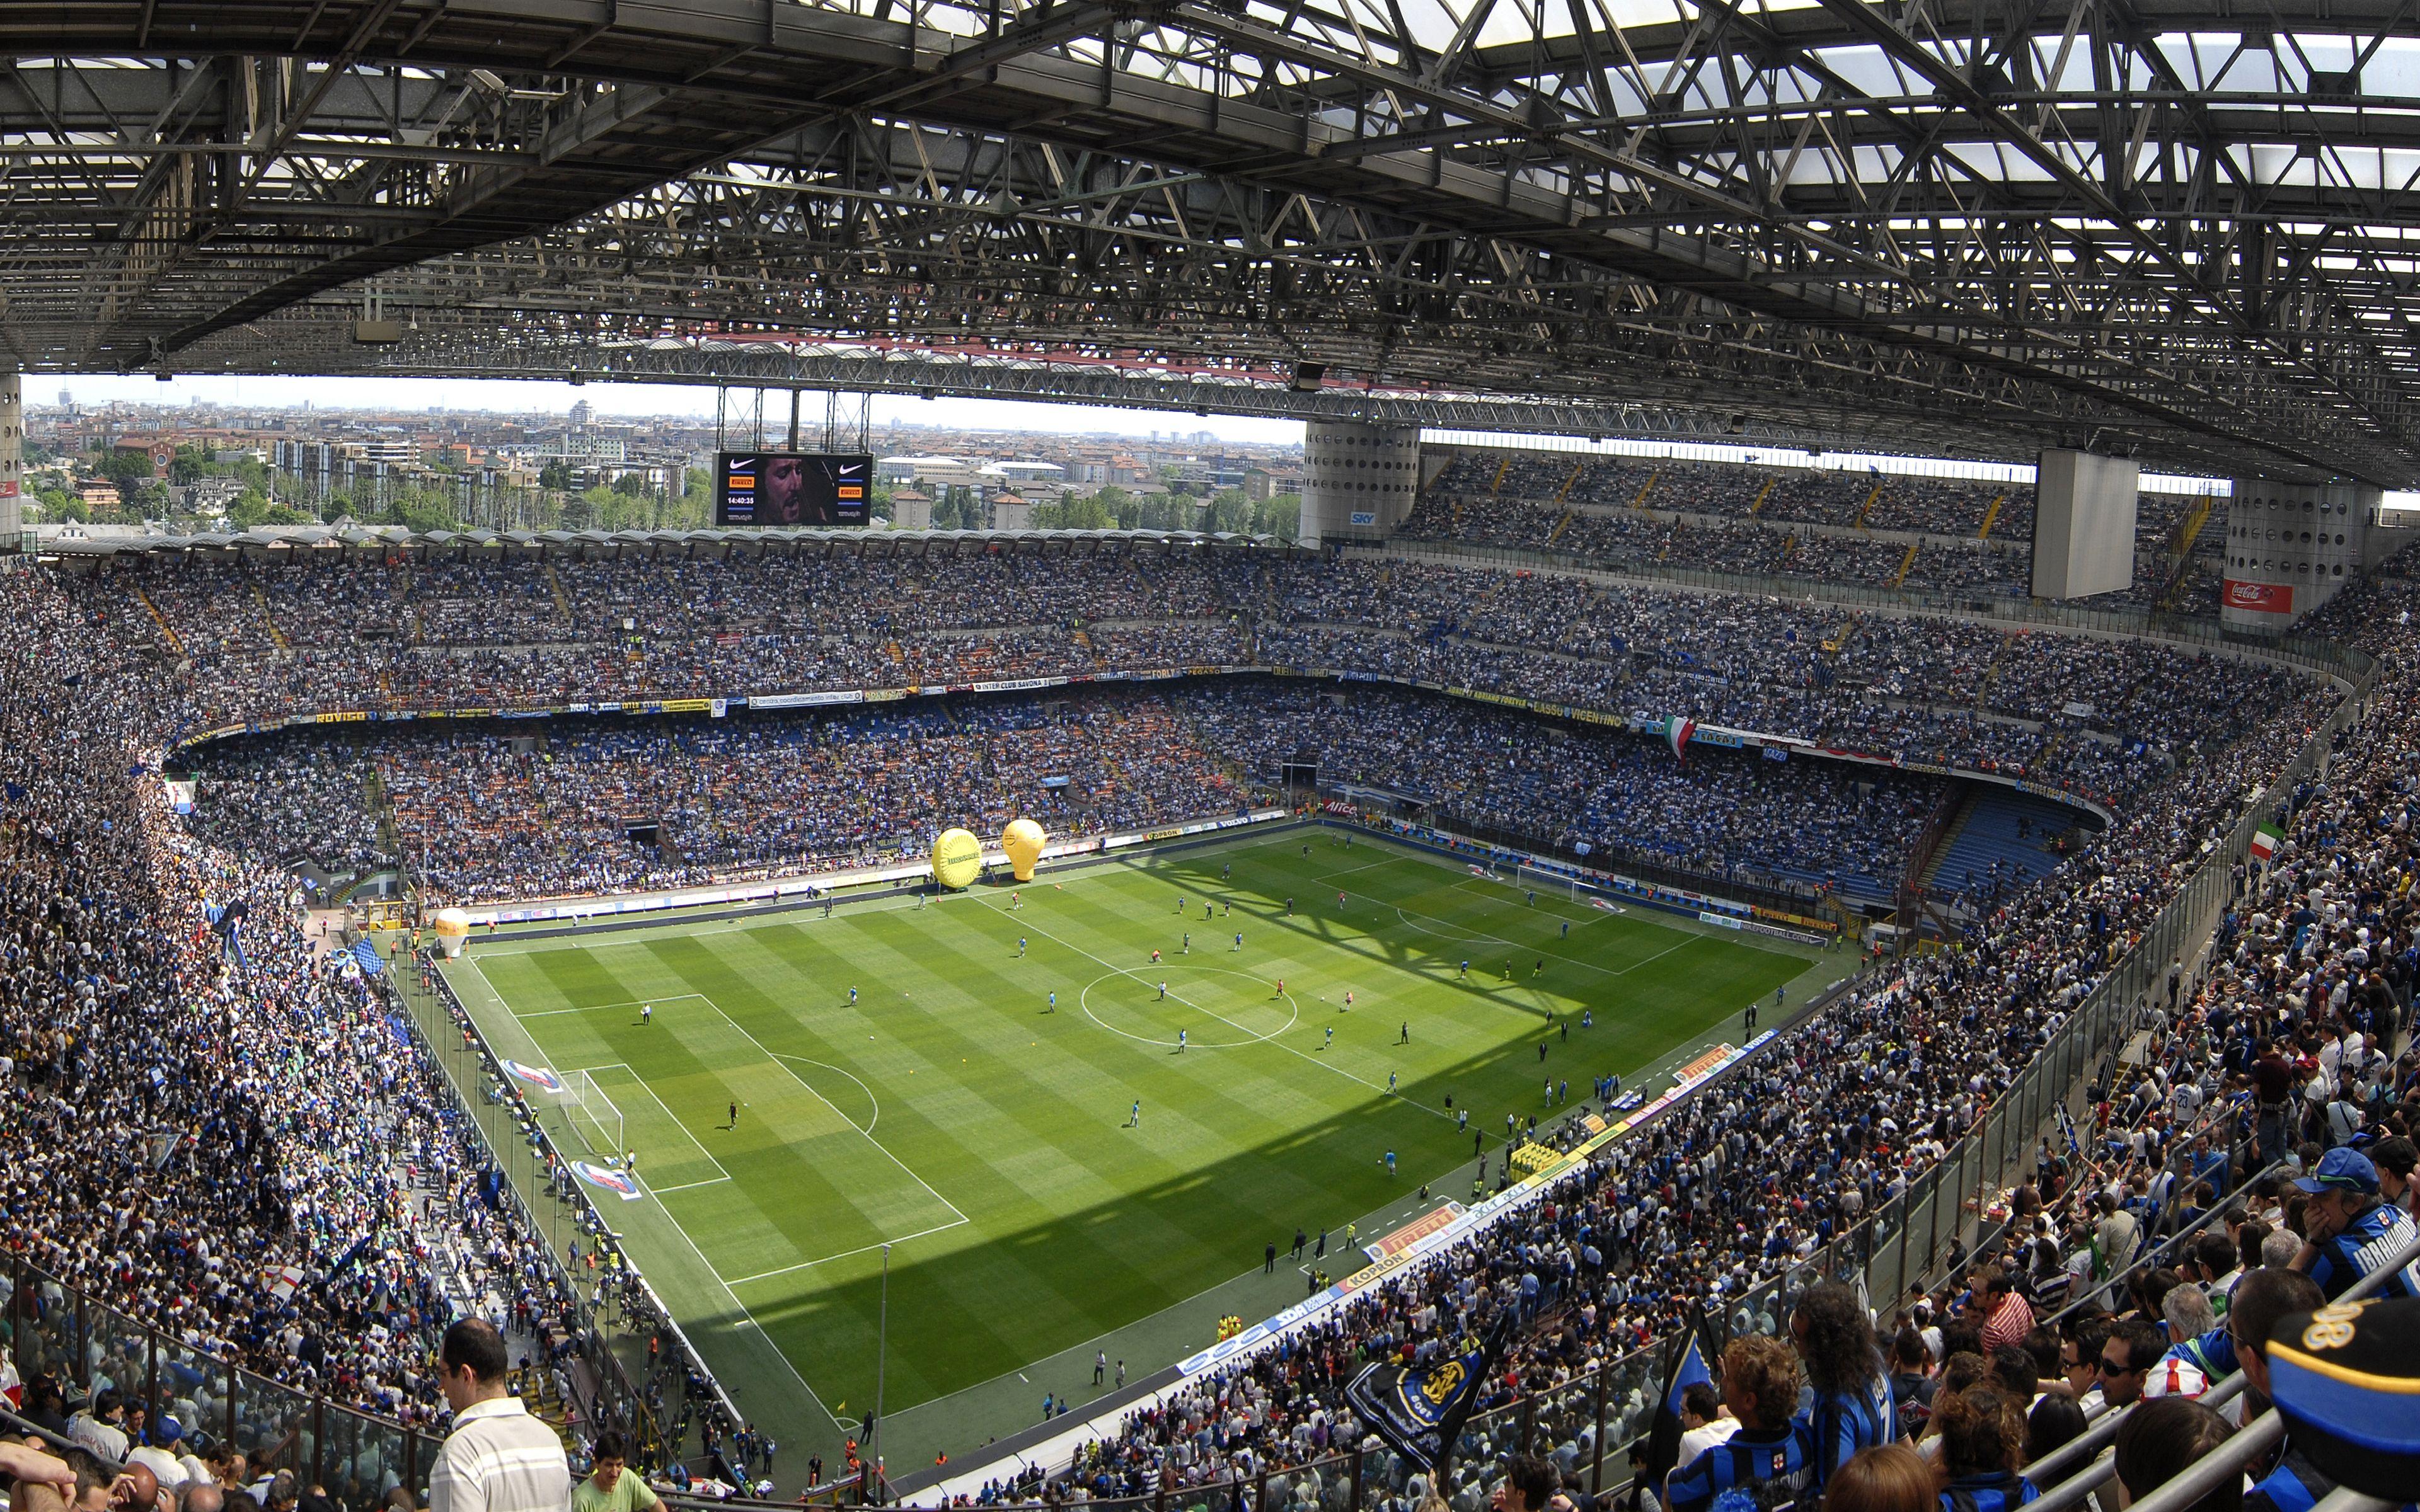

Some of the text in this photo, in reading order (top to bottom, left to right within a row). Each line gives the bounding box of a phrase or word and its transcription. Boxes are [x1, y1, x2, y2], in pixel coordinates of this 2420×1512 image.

[1352, 513, 1374, 524] SKY
[780, 695, 824, 704] coordinamento
[316, 712, 366, 723] ROVIGO
[1571, 707, 1622, 727] VICENTINO
[1220, 817, 1248, 827] VOLVO
[1741, 922, 1809, 944] NIKEFOOTBALL.COM
[1745, 1030, 1775, 1050] VOLVO
[1679, 1046, 1729, 1079] PIRELLI
[2177, 1094, 2188, 1109] 23
[1502, 1184, 1526, 1201] acer
[1473, 1199, 1498, 1218] acer
[1379, 1208, 1455, 1256] PIRELLI
[1350, 1253, 1405, 1286] KOPRON
[1275, 1304, 1309, 1326] SDA
